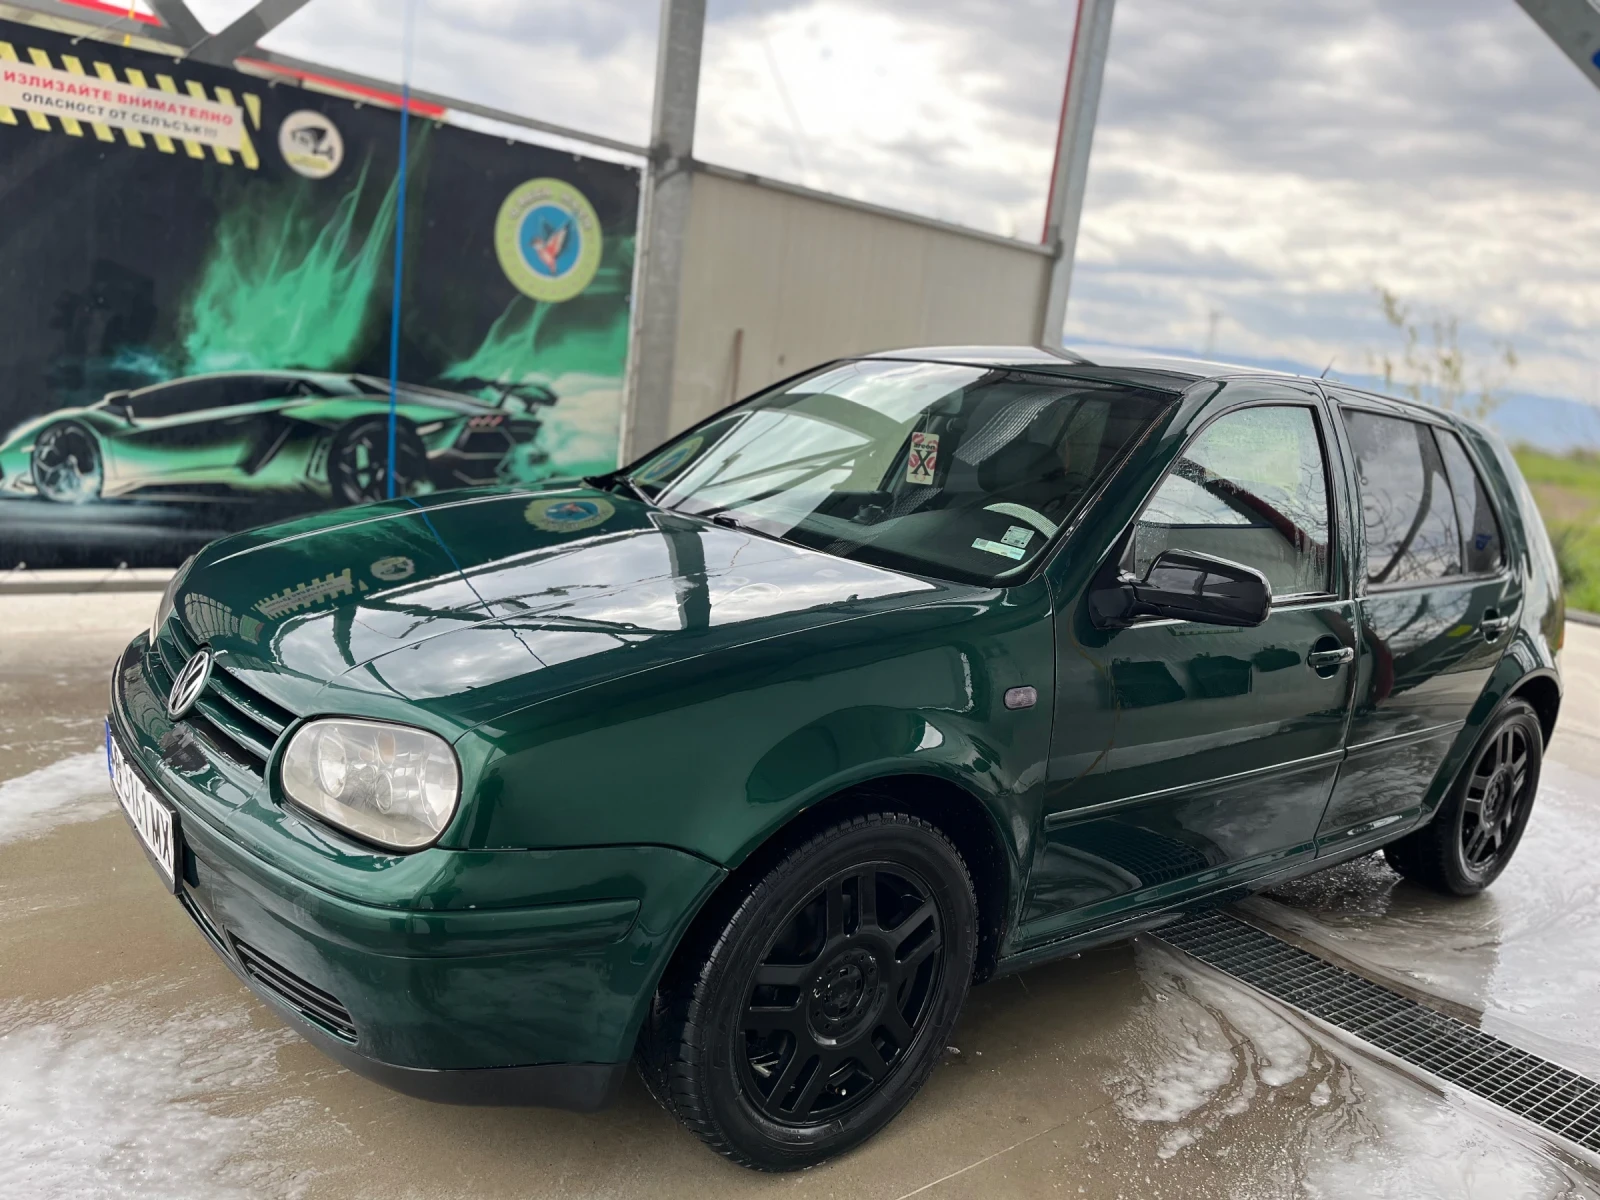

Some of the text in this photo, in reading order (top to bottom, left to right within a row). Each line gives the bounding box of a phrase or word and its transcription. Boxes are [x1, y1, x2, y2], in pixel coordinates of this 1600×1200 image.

[3, 70, 234, 126] ИЗЛИЗАЙТЕ ВНИМАТЕЛНО
[22, 92, 105, 116] ОПАСНОСТ
[109, 108, 129, 120] ОТ
[910, 448, 937, 476] X
